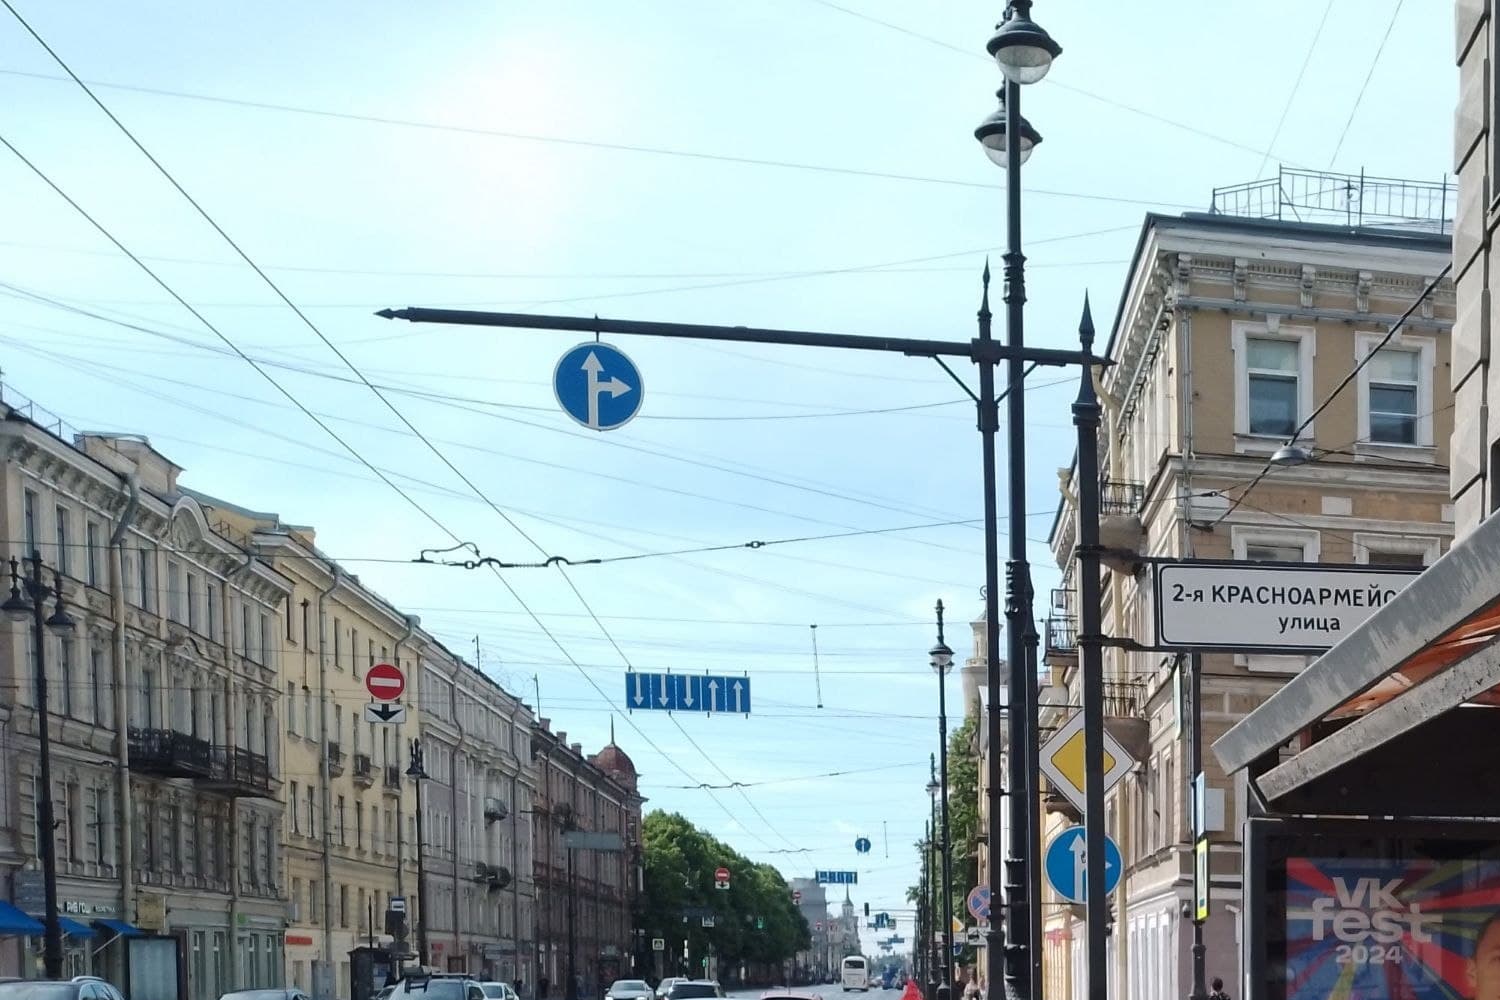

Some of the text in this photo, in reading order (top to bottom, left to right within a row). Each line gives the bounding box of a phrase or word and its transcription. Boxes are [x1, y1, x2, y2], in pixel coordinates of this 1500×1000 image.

[1172, 583, 1398, 607] 2-я КРАСНОАРМЕЙС
[1278, 615, 1341, 634] улица
[1333, 876, 1406, 909] VK
[1302, 897, 1440, 943] fest
[1335, 944, 1403, 965] 2024
